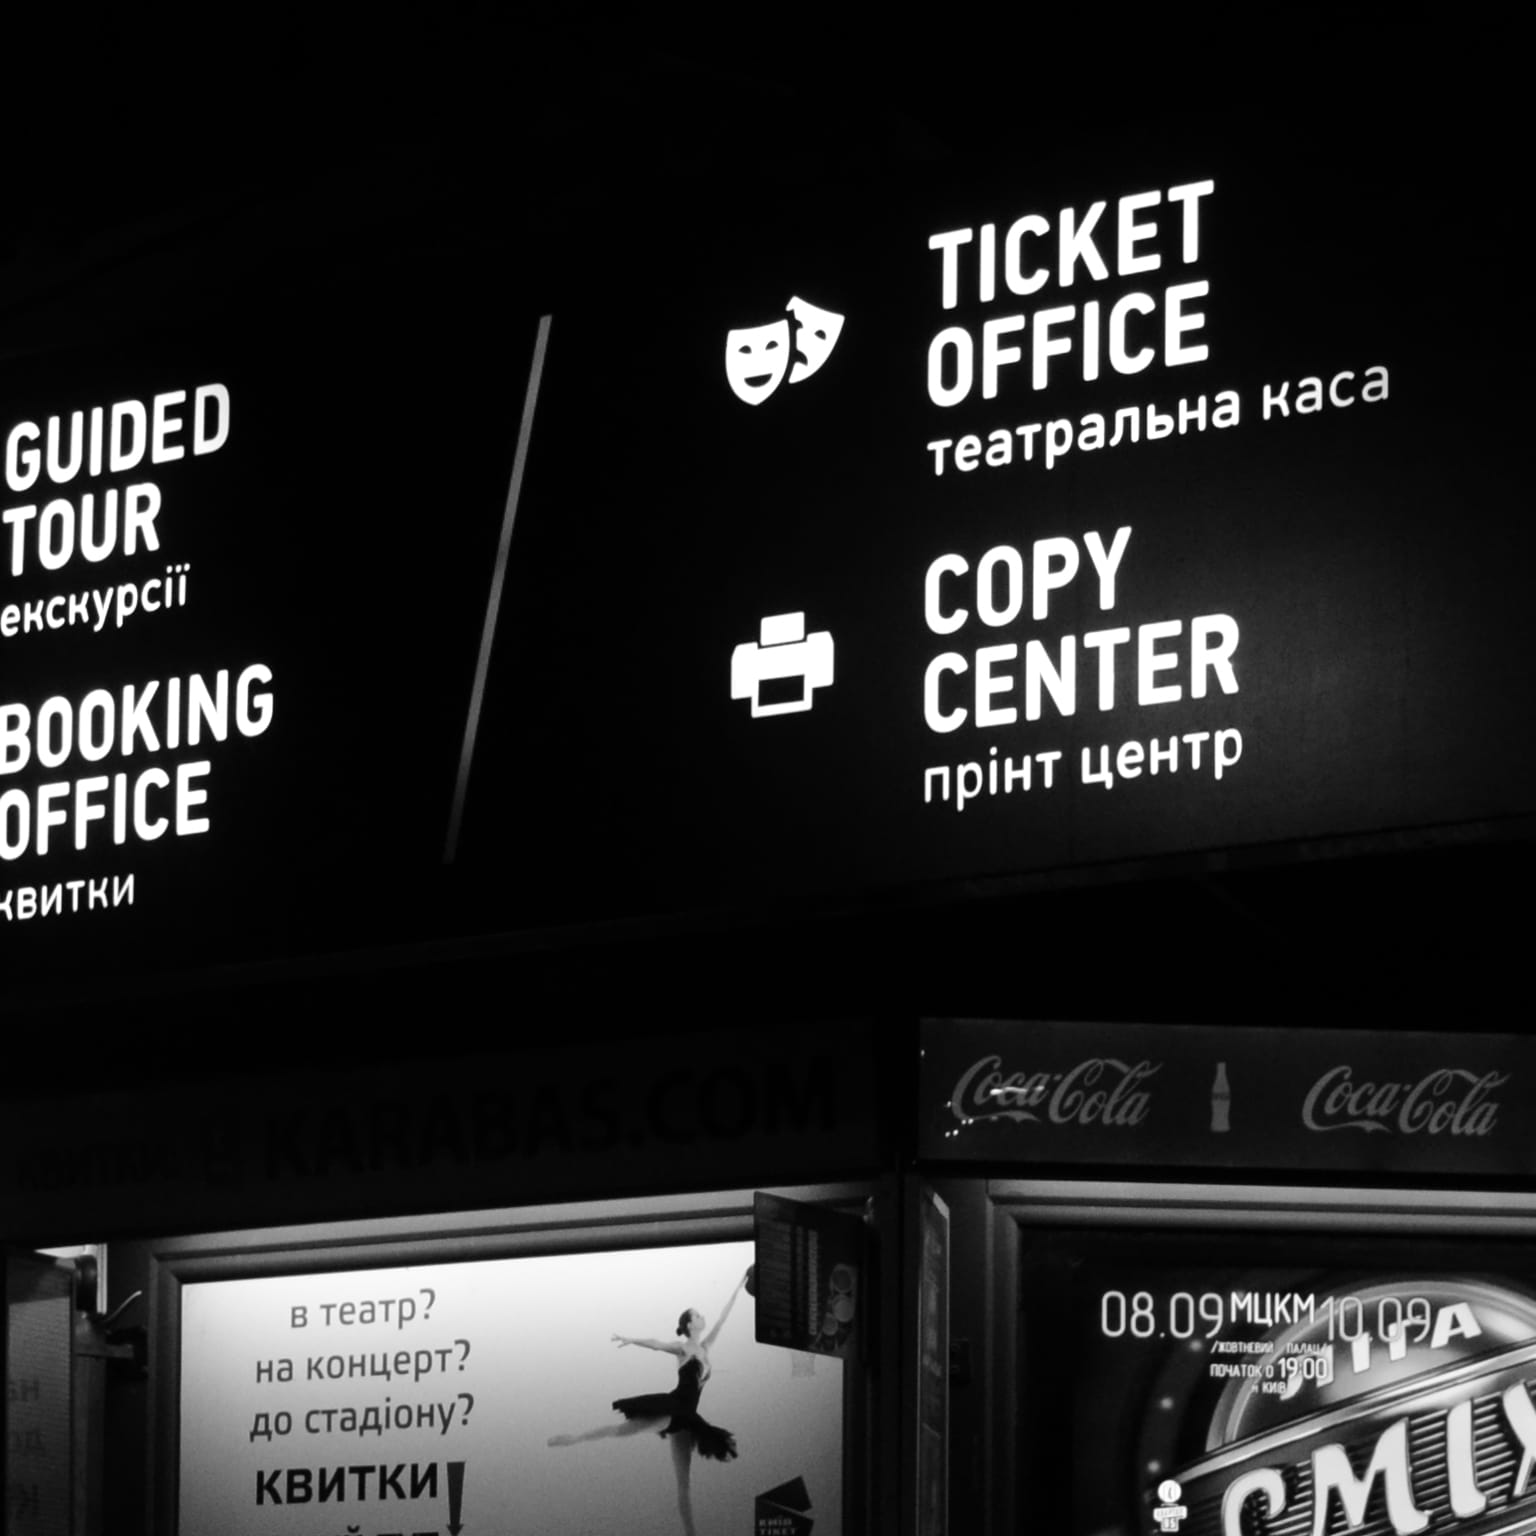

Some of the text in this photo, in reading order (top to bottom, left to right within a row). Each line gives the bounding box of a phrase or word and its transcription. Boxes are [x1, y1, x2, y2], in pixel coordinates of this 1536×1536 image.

[928, 179, 1215, 310] TICKET
[926, 280, 1210, 407] OFFICE
[4, 383, 230, 492] GUIDED
[926, 365, 1390, 476] театральна каса
[2, 483, 162, 577] TOUR
[0, 563, 191, 637] екскурсії
[924, 526, 1132, 635] COPY
[924, 612, 1240, 734] CENTER
[924, 727, 1243, 811] прінт центр
[265, 1055, 836, 1180] KARABAS.COM
[952, 1054, 1162, 1128] Coca-Cola
[1301, 1062, 1511, 1138] Coca-Cola
[289, 1287, 436, 1331] в театр?
[1101, 1290, 1224, 1339] 08.09
[1230, 1291, 1315, 1328] МЦКМ
[1320, 1296, 1431, 1343] 10.09
[254, 1338, 472, 1384] на концерт?
[249, 1392, 475, 1443] до стадіону?
